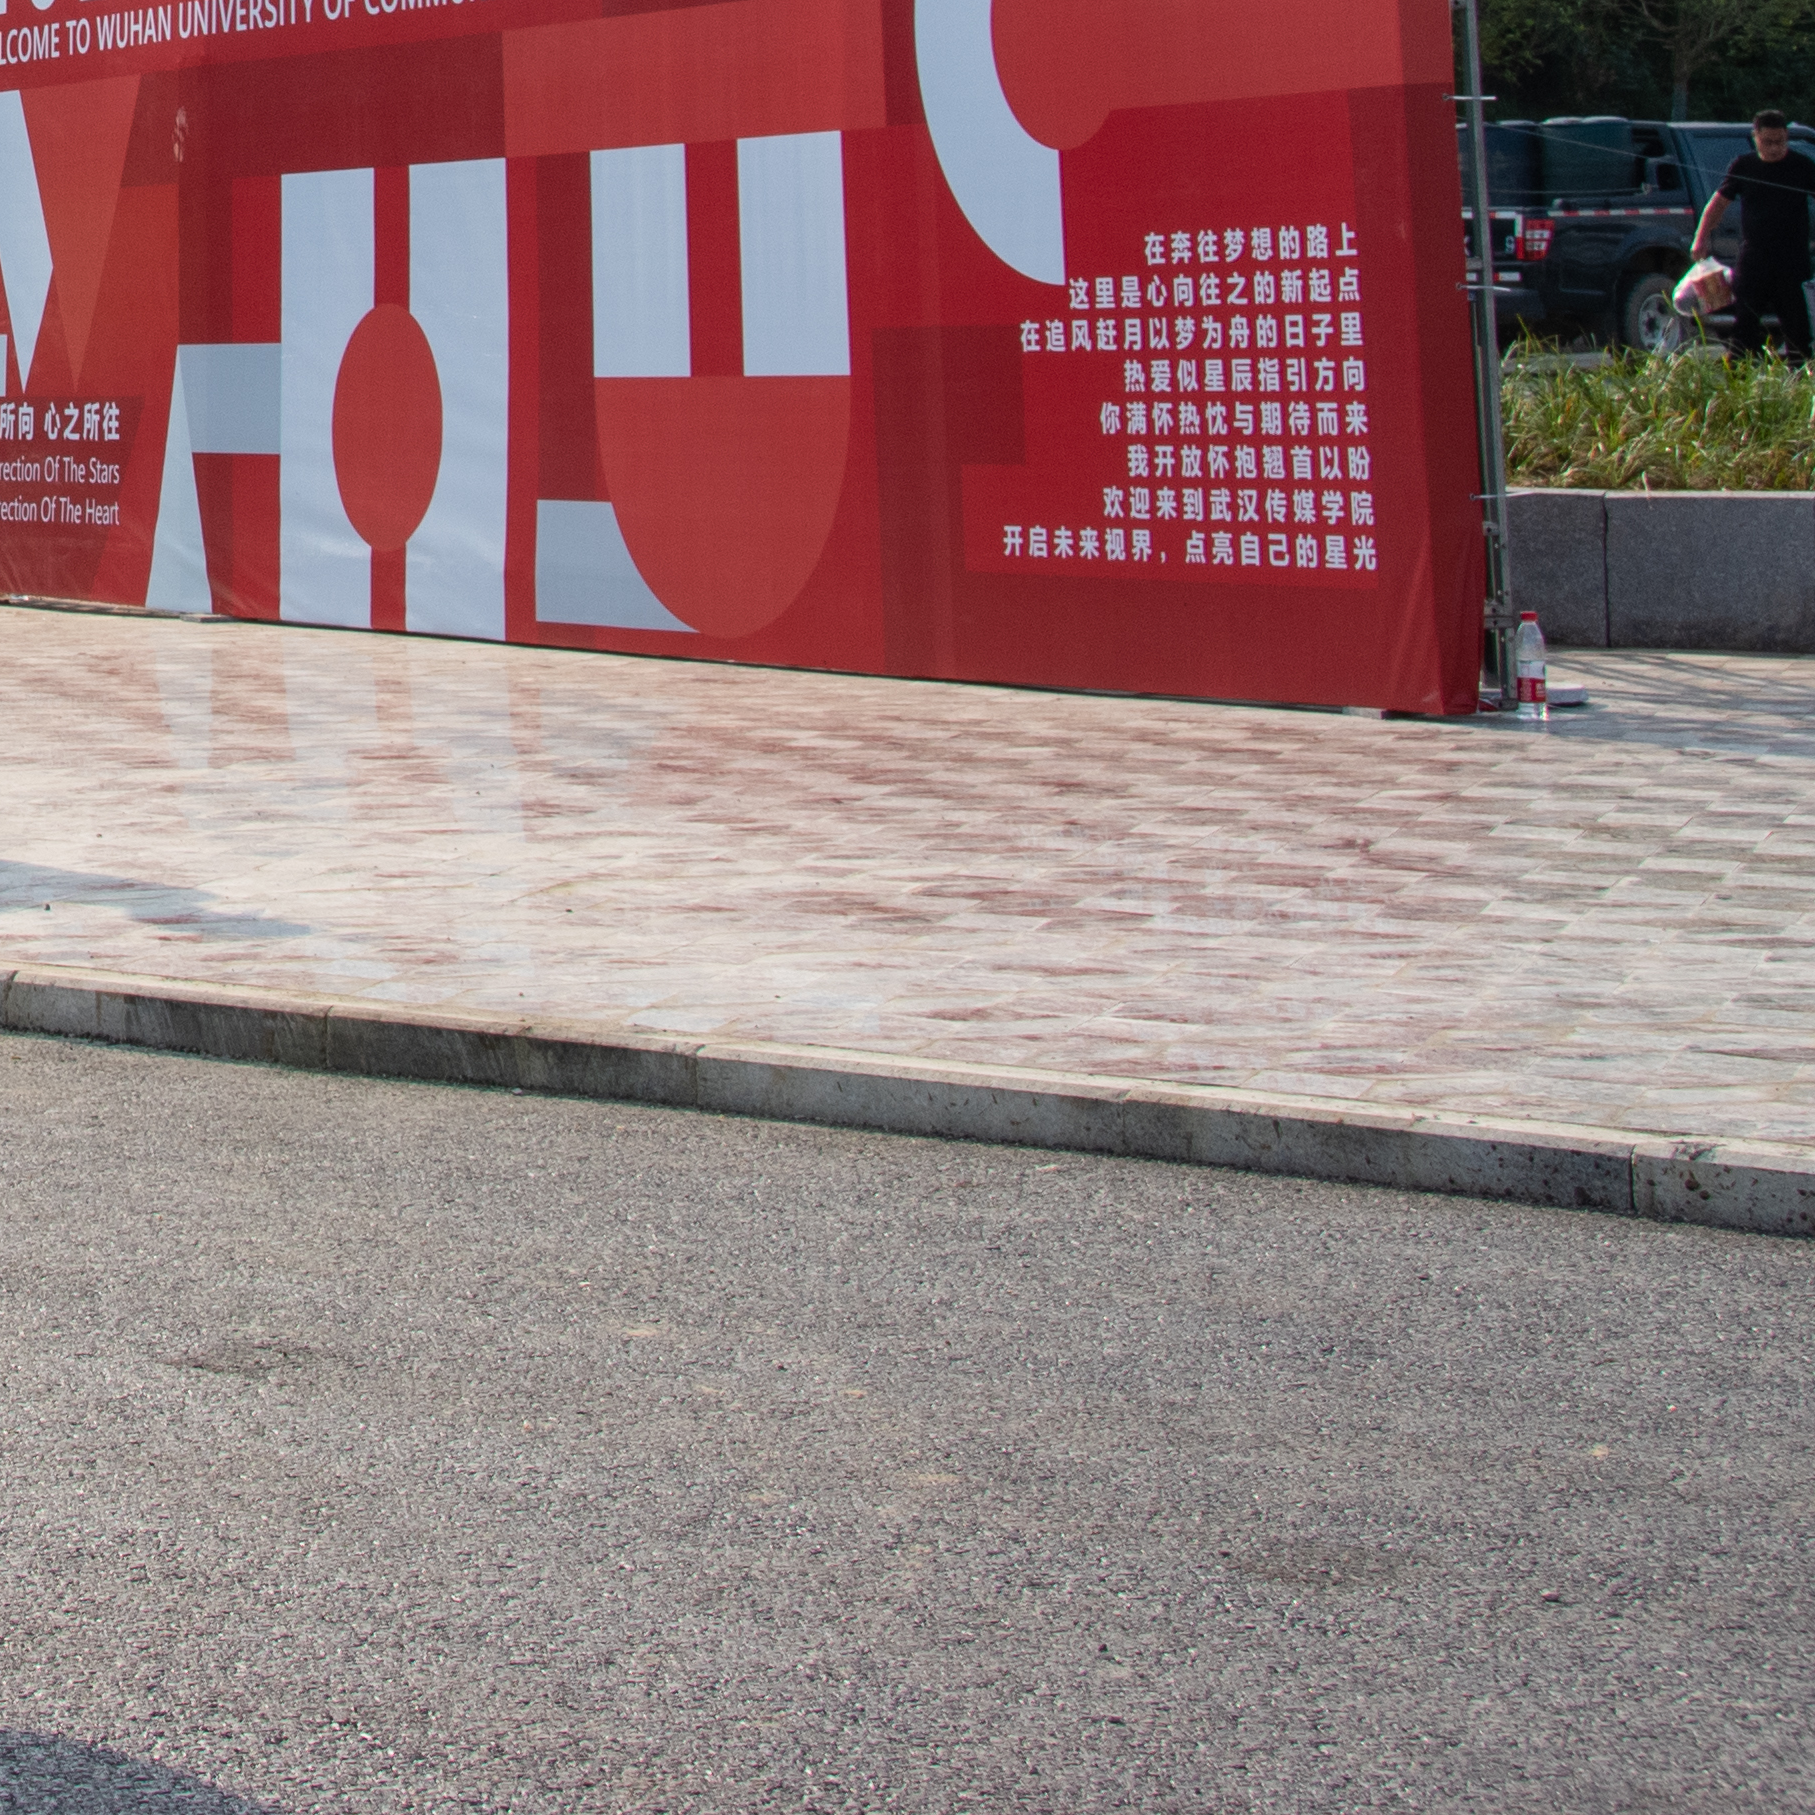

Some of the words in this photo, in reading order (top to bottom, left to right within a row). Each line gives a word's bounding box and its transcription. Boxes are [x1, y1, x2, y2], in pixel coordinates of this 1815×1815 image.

[66, 19, 90, 55] TO
[97, 5, 171, 51] WUHAN
[1144, 222, 1359, 266] 在奔往梦想的路上
[1068, 267, 1361, 310] 这里是心向往之的新起点
[1020, 311, 1364, 353] 在追风赶月以梦为舟的日子里
[1123, 356, 1365, 393] 热爱似星辰指引方向
[44, 401, 120, 441] 心之所往
[1099, 400, 1368, 436] 你满怀热忱与期待而来
[44, 455, 61, 483] Of
[63, 456, 86, 484] The
[89, 457, 120, 485] Stars
[1127, 444, 1371, 481] 我开放怀抱翘首以盼
[41, 495, 57, 523] Of
[59, 496, 81, 525] The
[85, 498, 120, 526] Heart
[1103, 486, 1374, 526] 欢迎来到武汉传媒学院
